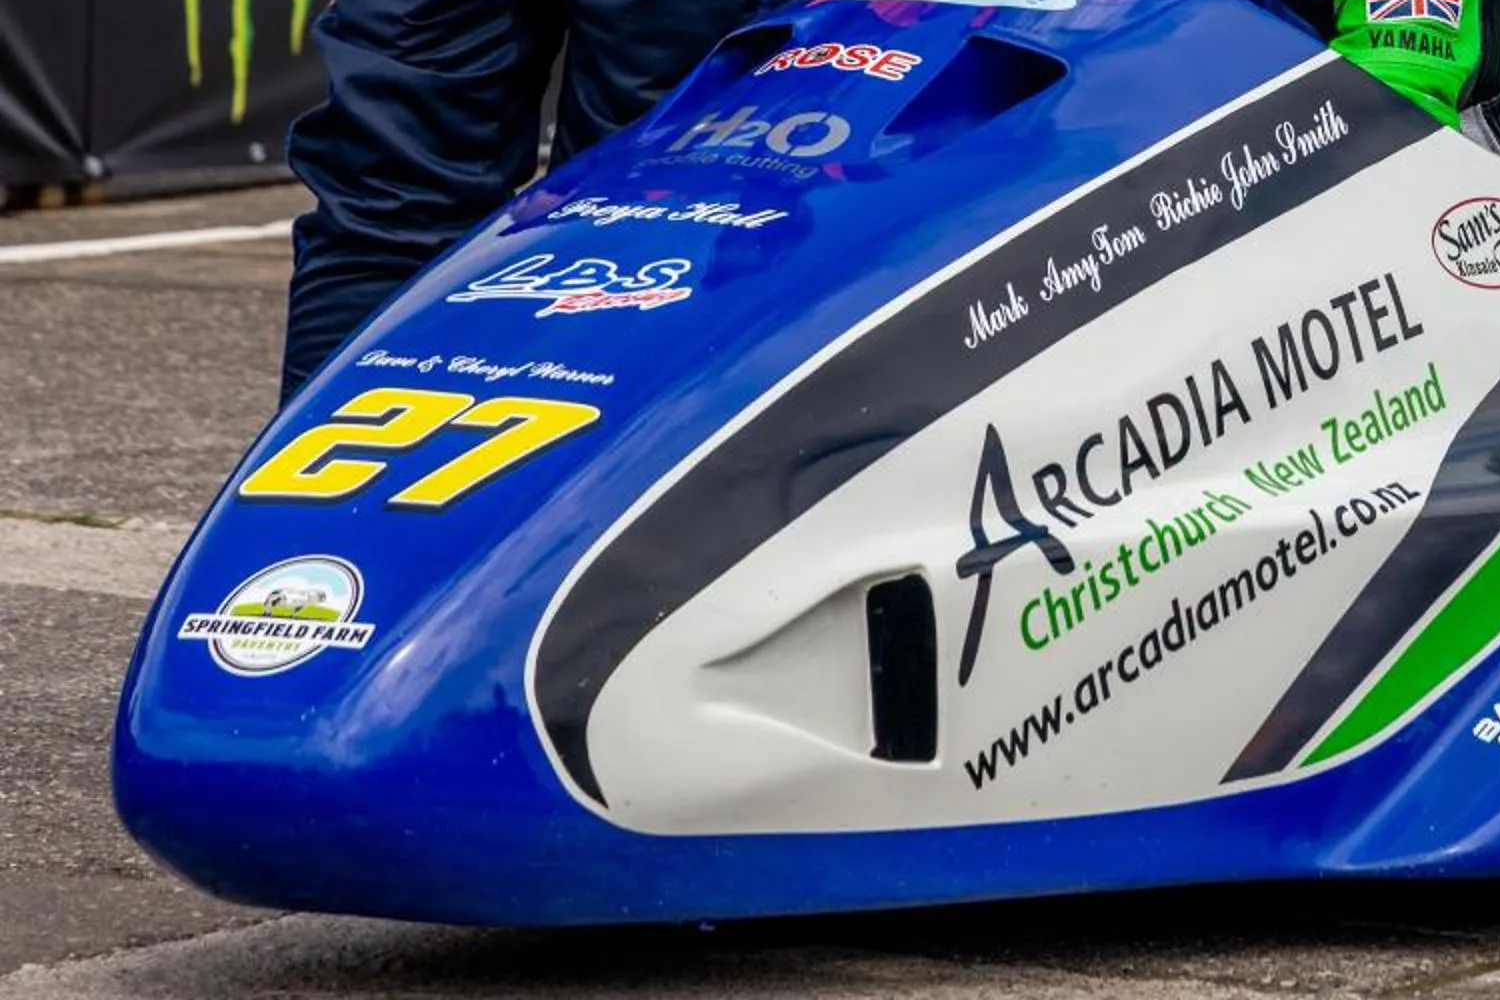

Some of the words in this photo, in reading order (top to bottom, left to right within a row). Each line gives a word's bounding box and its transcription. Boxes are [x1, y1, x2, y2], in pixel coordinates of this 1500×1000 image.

[754, 42, 923, 82] ROSE
[1368, 29, 1456, 61] YAMAHA
[666, 105, 851, 157] H2O
[725, 154, 819, 179] cutting
[667, 203, 790, 230] Hall
[964, 281, 1029, 350] Mark
[1039, 256, 1102, 294] Amy
[1090, 223, 1147, 266] Tom
[1149, 175, 1224, 232] Richie
[1219, 143, 1281, 212] John
[1274, 99, 1350, 167] Smith
[446, 253, 692, 303] LBS
[1250, 273, 1425, 410] MOTEL
[236, 385, 601, 513] 27
[1019, 488, 1254, 653] Christchurch
[1242, 443, 1327, 498] New
[1320, 361, 1448, 466] Zealand
[183, 618, 308, 640] SPRINGFIELD
[311, 625, 370, 644] FARM
[964, 479, 1421, 791] www.arcadiamotel.co.nz
